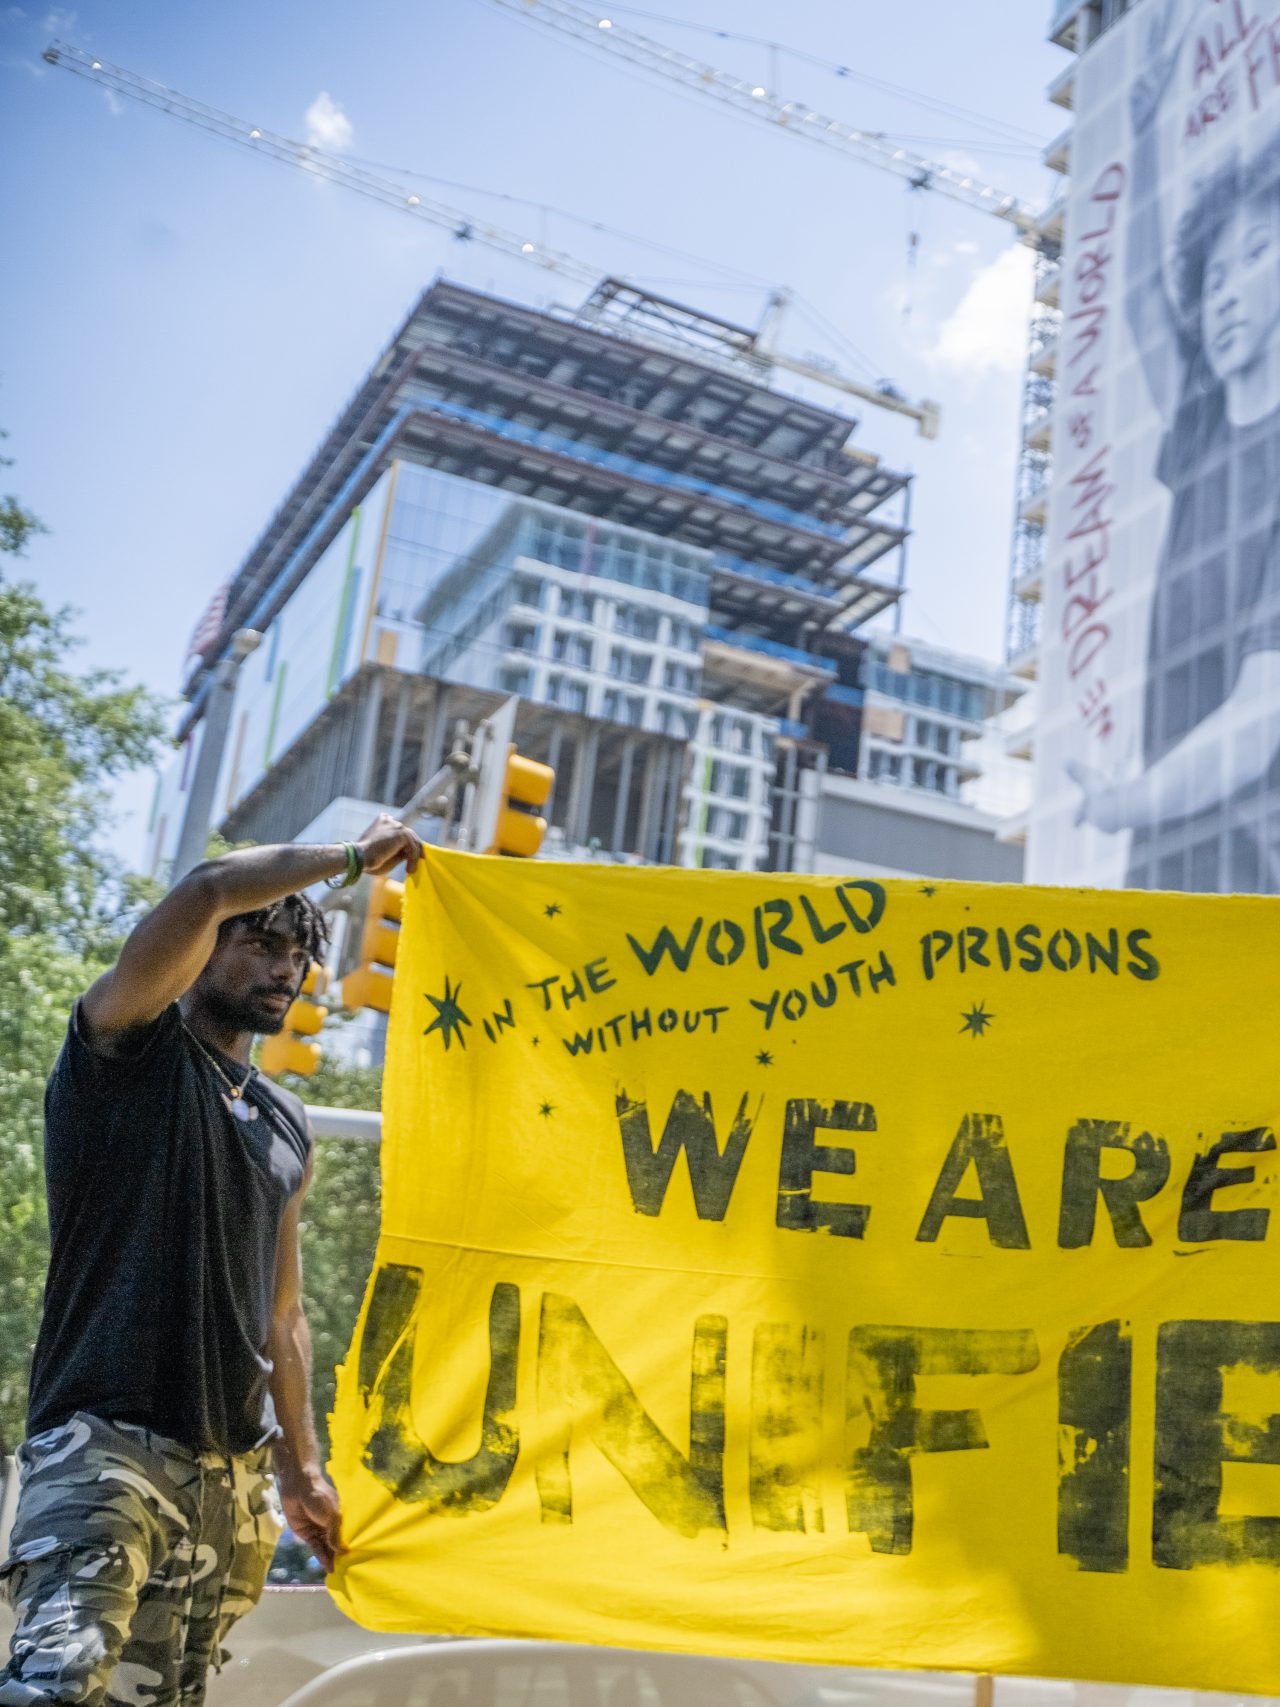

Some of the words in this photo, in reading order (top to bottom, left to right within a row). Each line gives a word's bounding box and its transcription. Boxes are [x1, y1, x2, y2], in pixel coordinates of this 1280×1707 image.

[1066, 160, 1126, 368] WORLD
[1071, 364, 1099, 397] A
[1061, 443, 1117, 677] DREAM
[483, 999, 515, 1044] IN
[526, 956, 617, 1012] THE
[626, 879, 886, 977] WORLD
[562, 1004, 729, 1057] WITHOUT
[749, 949, 896, 1031] YOUTH
[921, 923, 1161, 981] PRISONS
[614, 1086, 880, 1241] WE
[914, 1110, 1278, 1252] ARE
